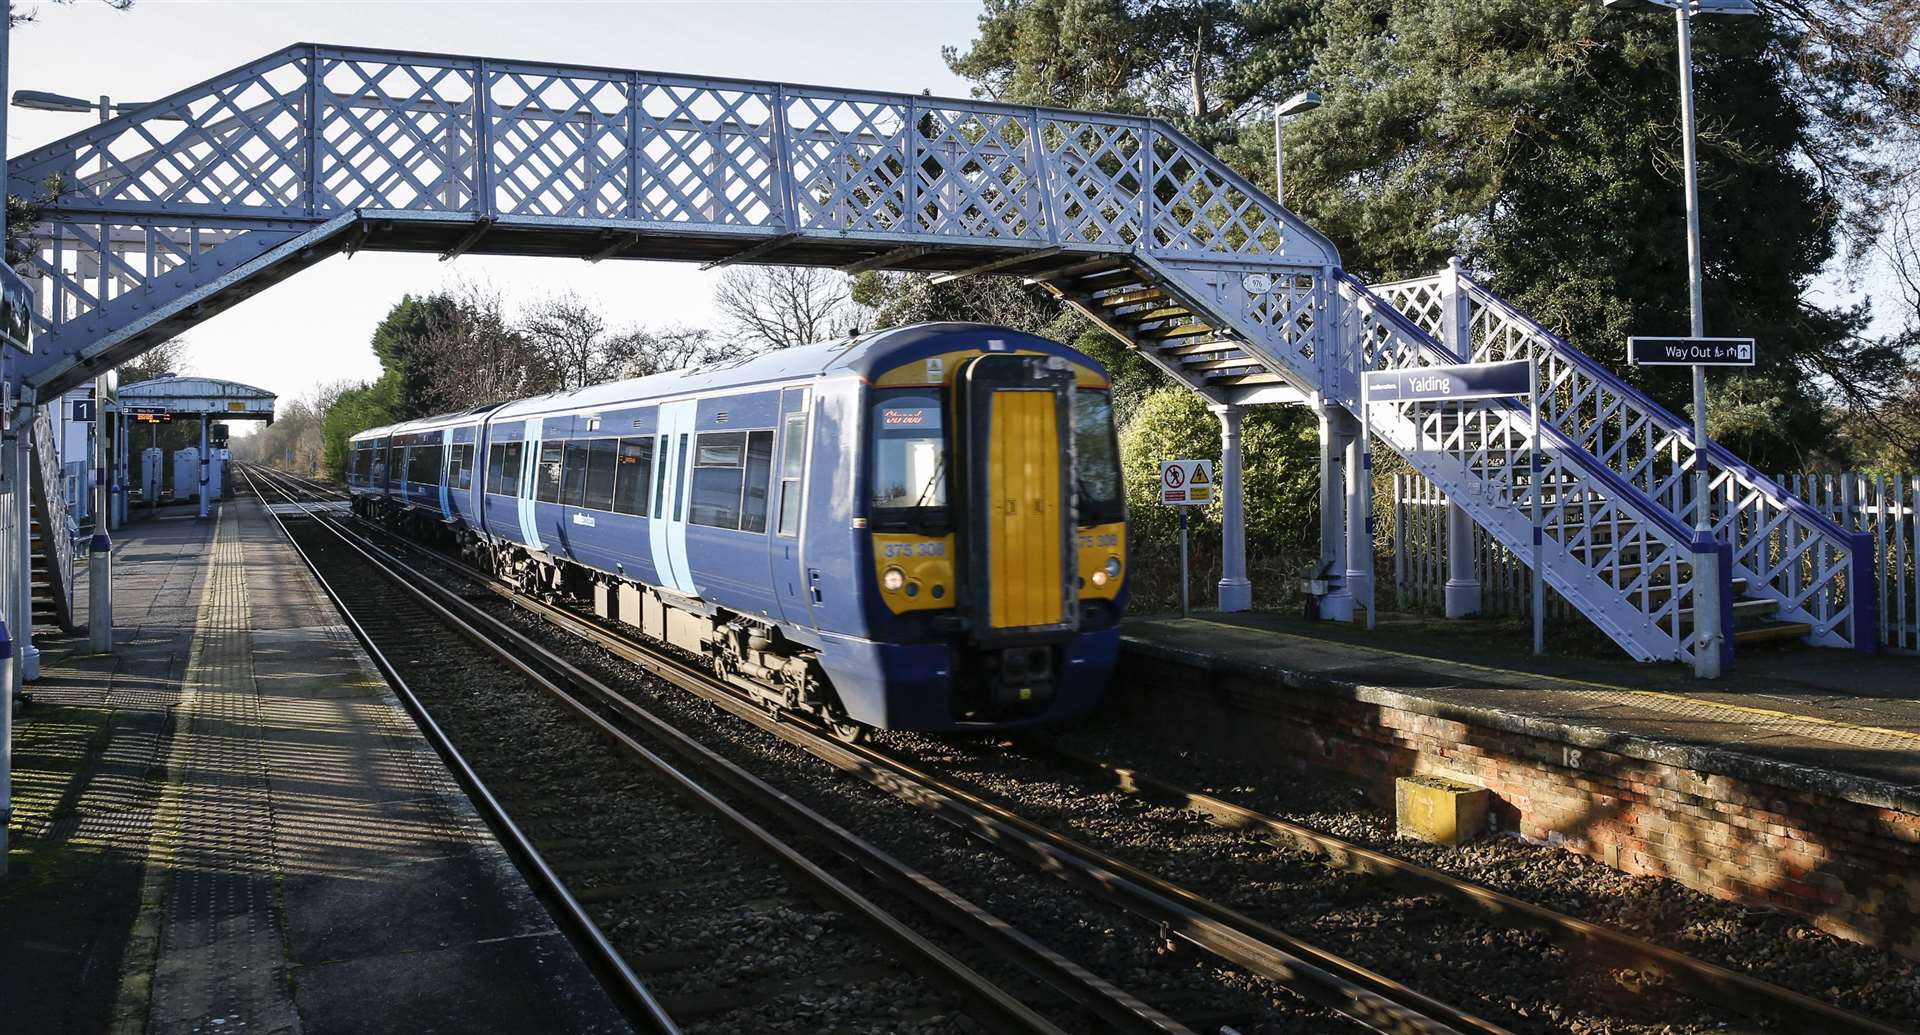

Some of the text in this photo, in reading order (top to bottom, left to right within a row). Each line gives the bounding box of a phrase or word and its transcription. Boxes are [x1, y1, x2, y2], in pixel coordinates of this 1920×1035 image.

[1665, 345, 1711, 360] Way Out
[1408, 376, 1450, 394] Yalding
[79, 403, 88, 419] 1
[886, 543, 913, 558] 375
[1562, 746, 1582, 769] 18
